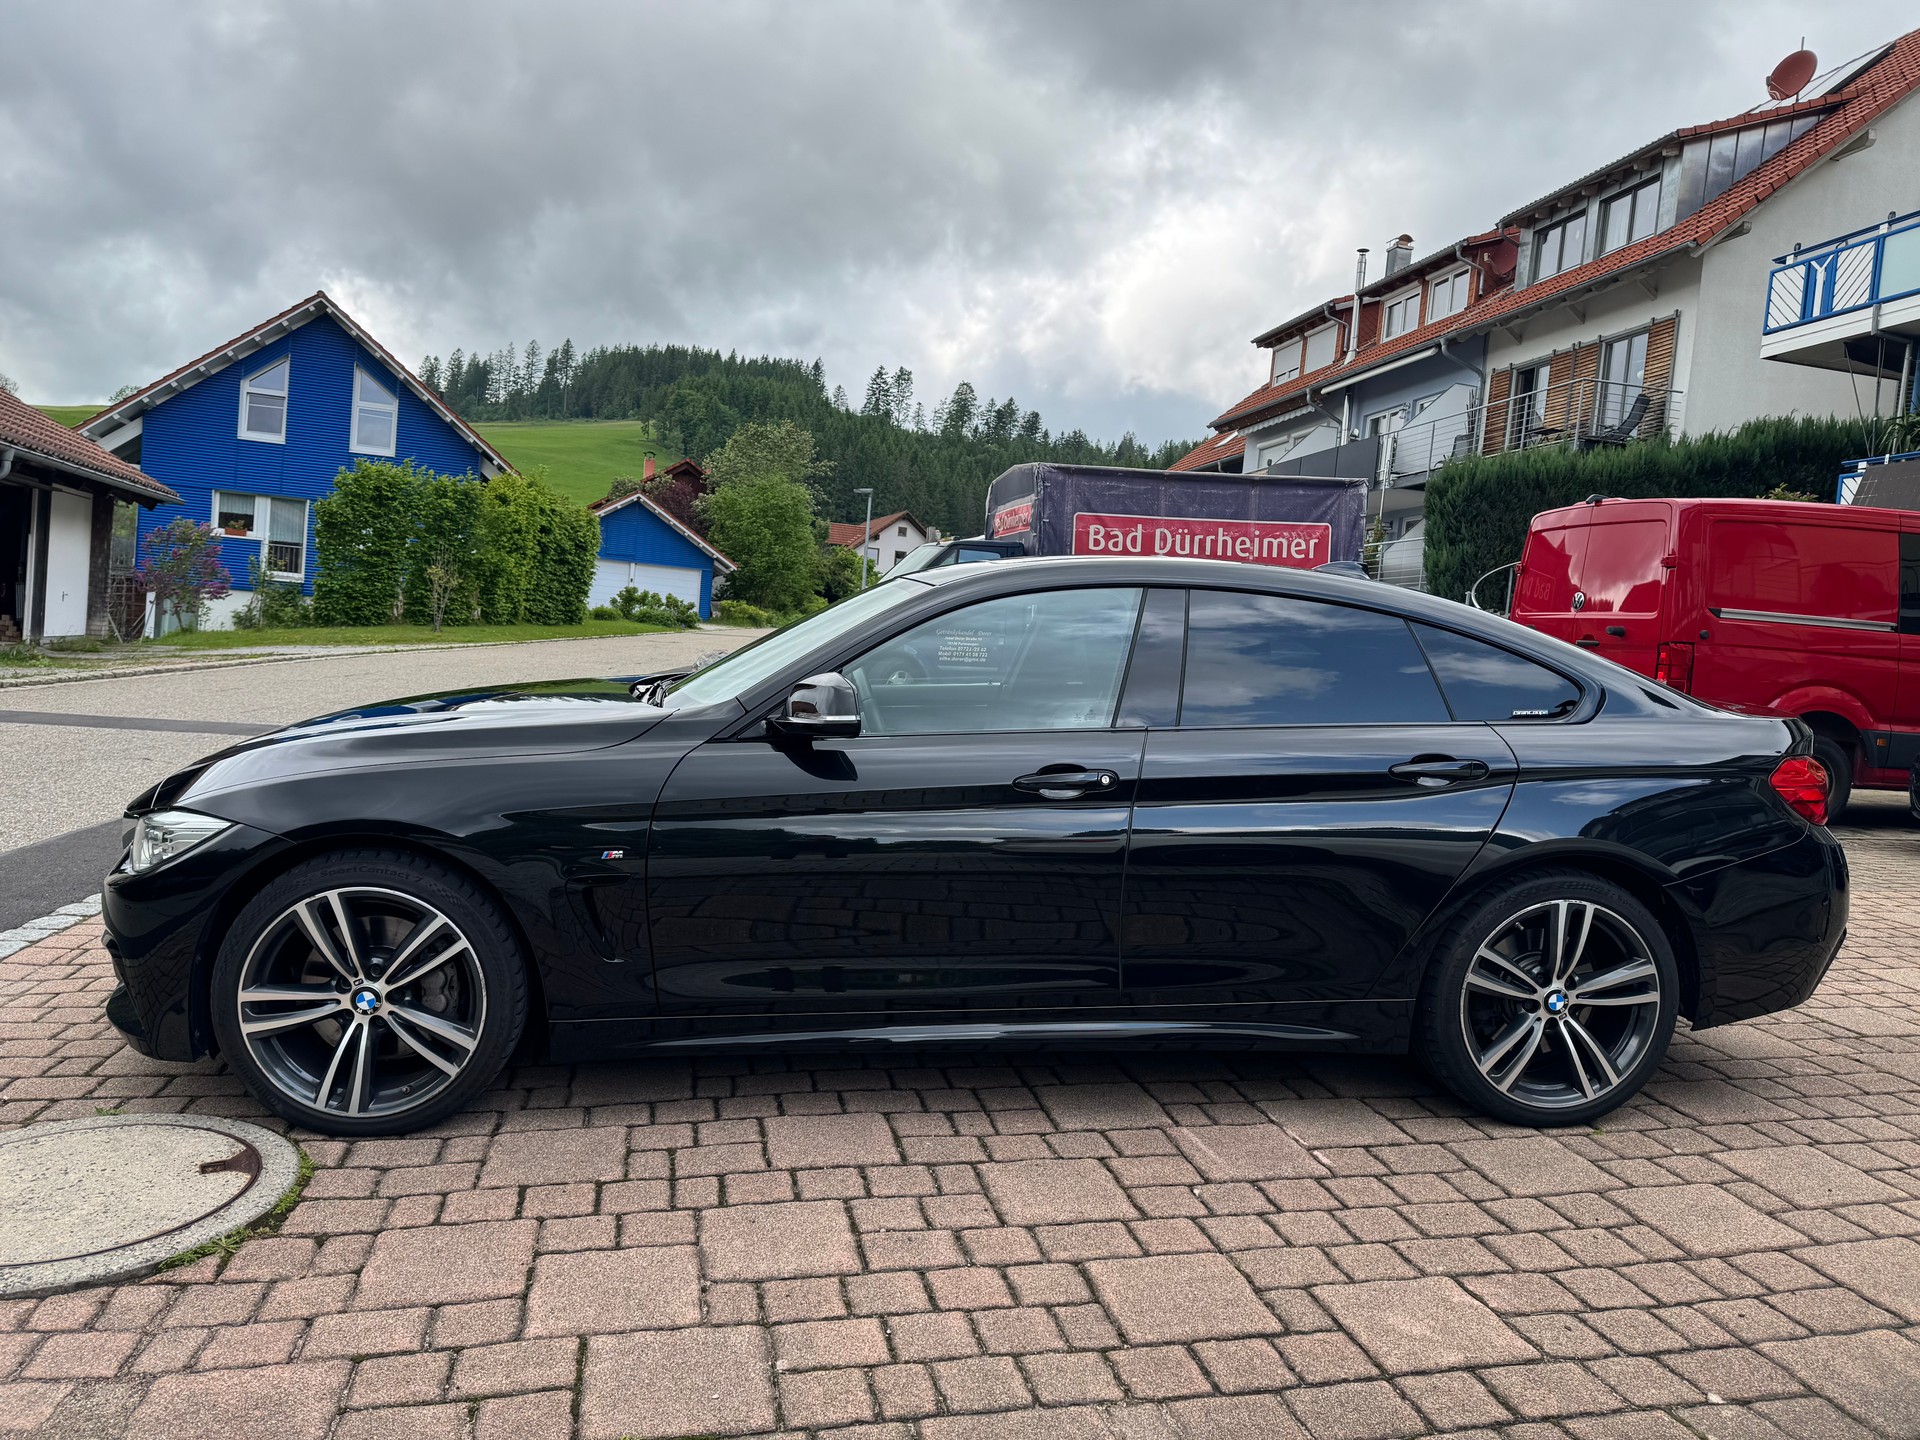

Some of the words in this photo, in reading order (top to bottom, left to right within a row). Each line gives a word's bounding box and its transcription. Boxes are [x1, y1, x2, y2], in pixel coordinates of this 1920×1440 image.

[1088, 523, 1142, 553] Bad
[1154, 527, 1319, 559] Dürrheimer
[320, 865, 411, 879] SportContact
